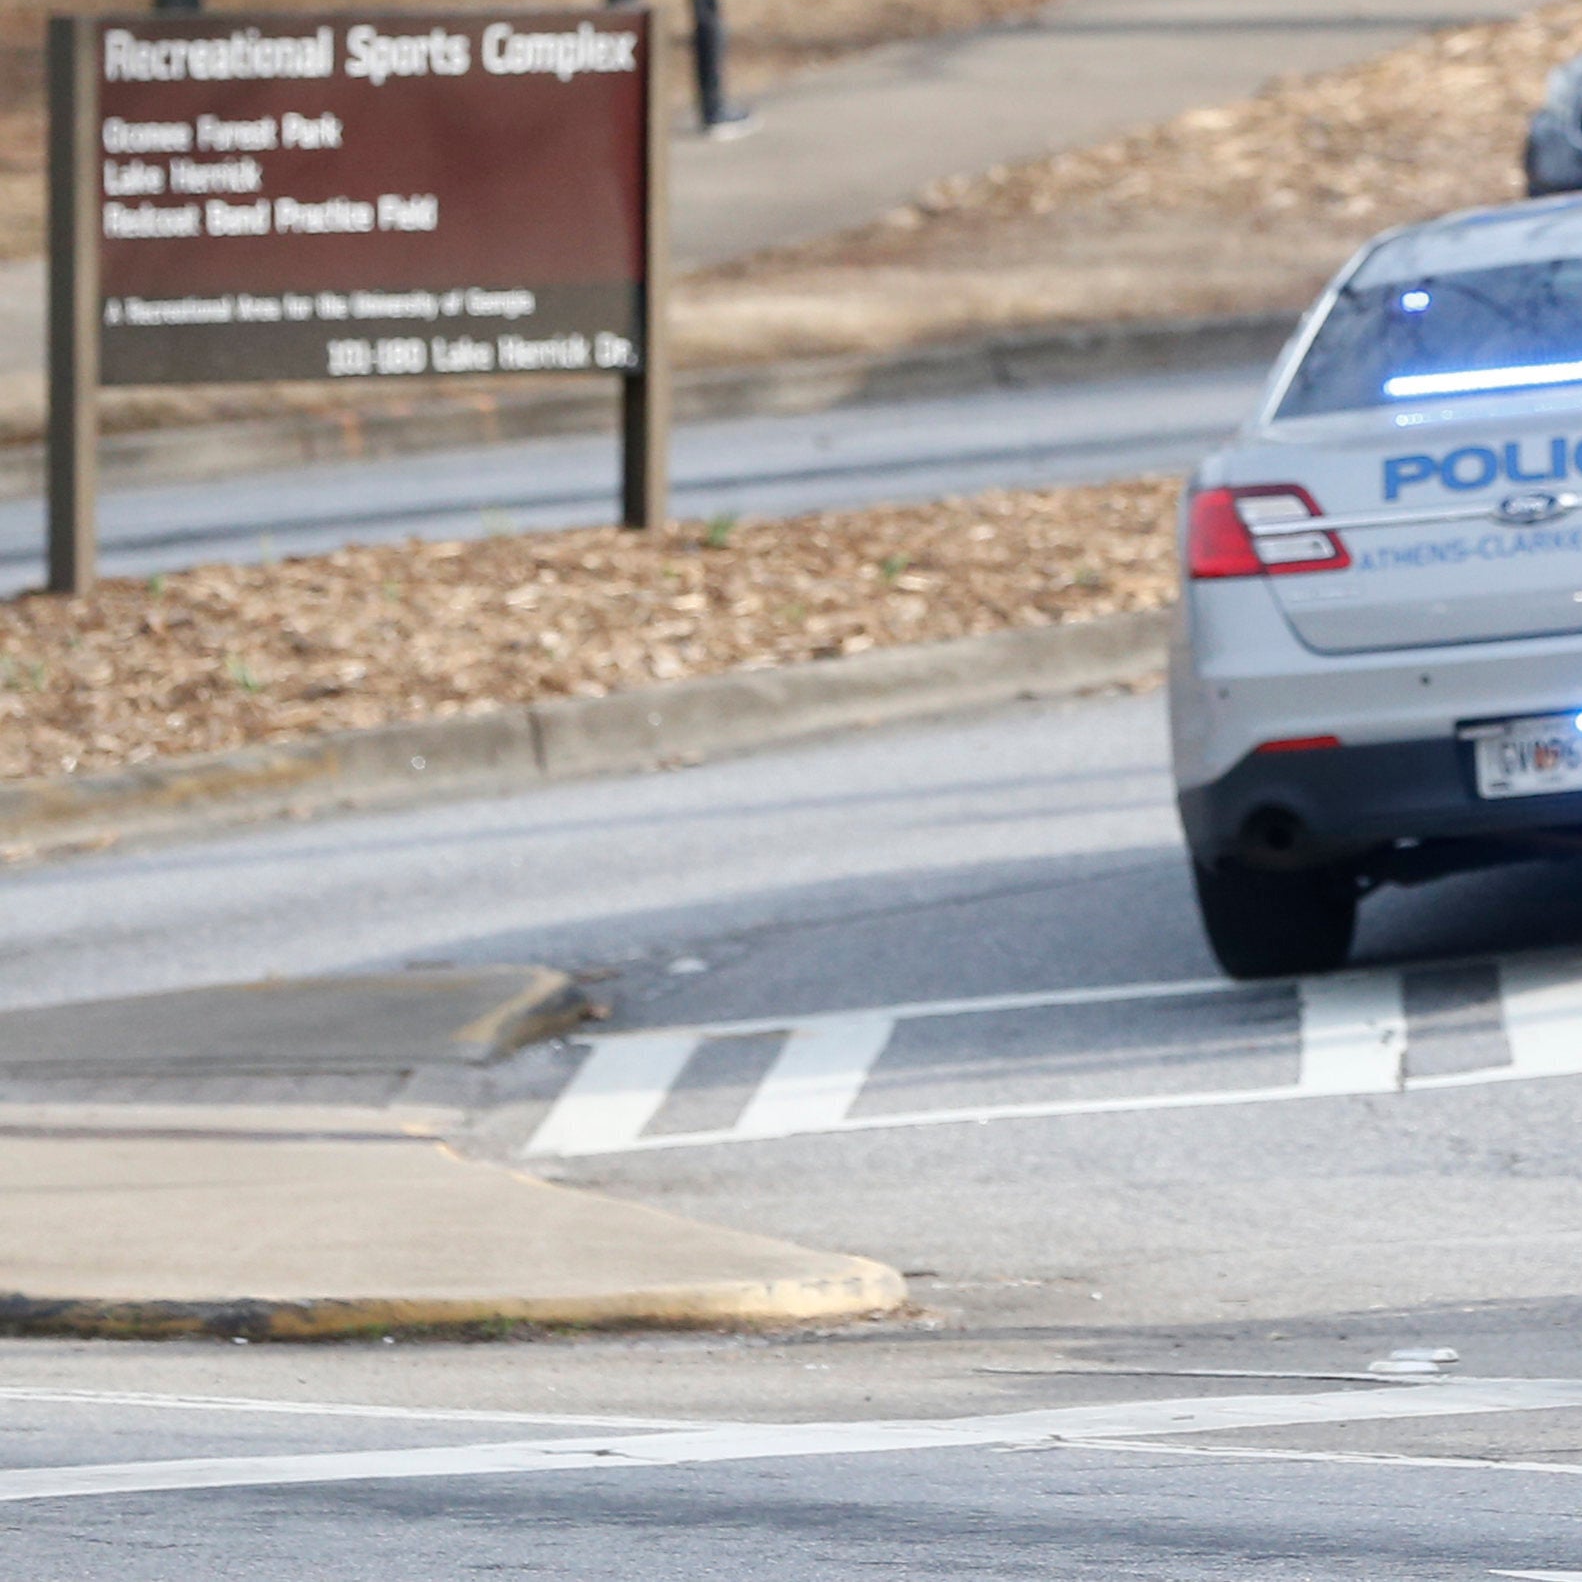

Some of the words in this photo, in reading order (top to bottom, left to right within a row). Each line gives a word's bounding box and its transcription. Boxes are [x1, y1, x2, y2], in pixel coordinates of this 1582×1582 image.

[105, 28, 333, 81] Recreational
[345, 25, 470, 86] Sports
[482, 22, 637, 82] Complex
[104, 159, 165, 195] Lake
[432, 335, 494, 372] Lake
